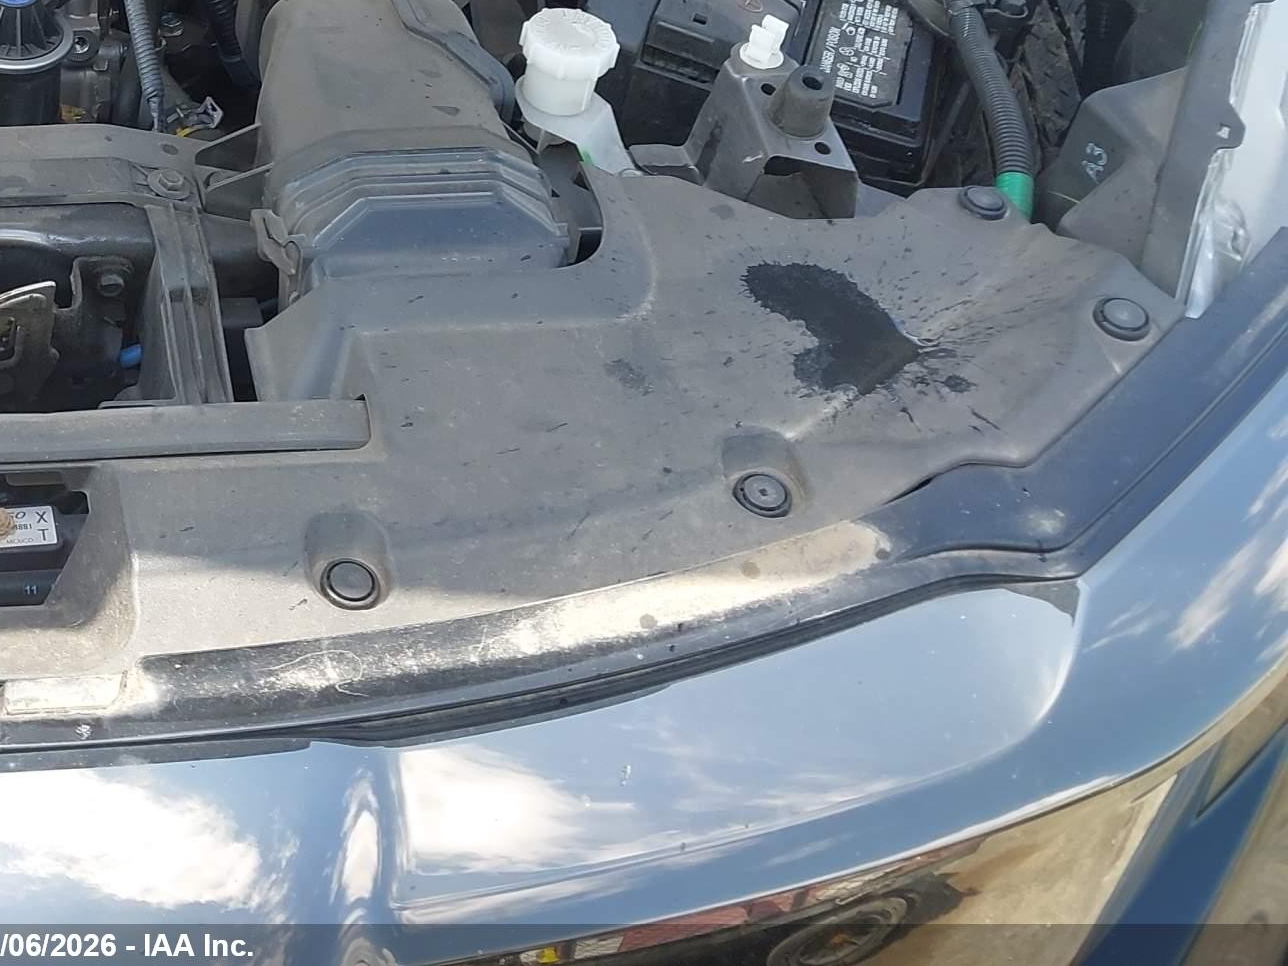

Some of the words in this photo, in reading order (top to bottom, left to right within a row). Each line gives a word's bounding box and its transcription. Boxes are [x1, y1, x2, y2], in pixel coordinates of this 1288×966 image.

[1082, 142, 1108, 184] A3
[35, 511, 49, 523] X
[37, 528, 49, 541] T
